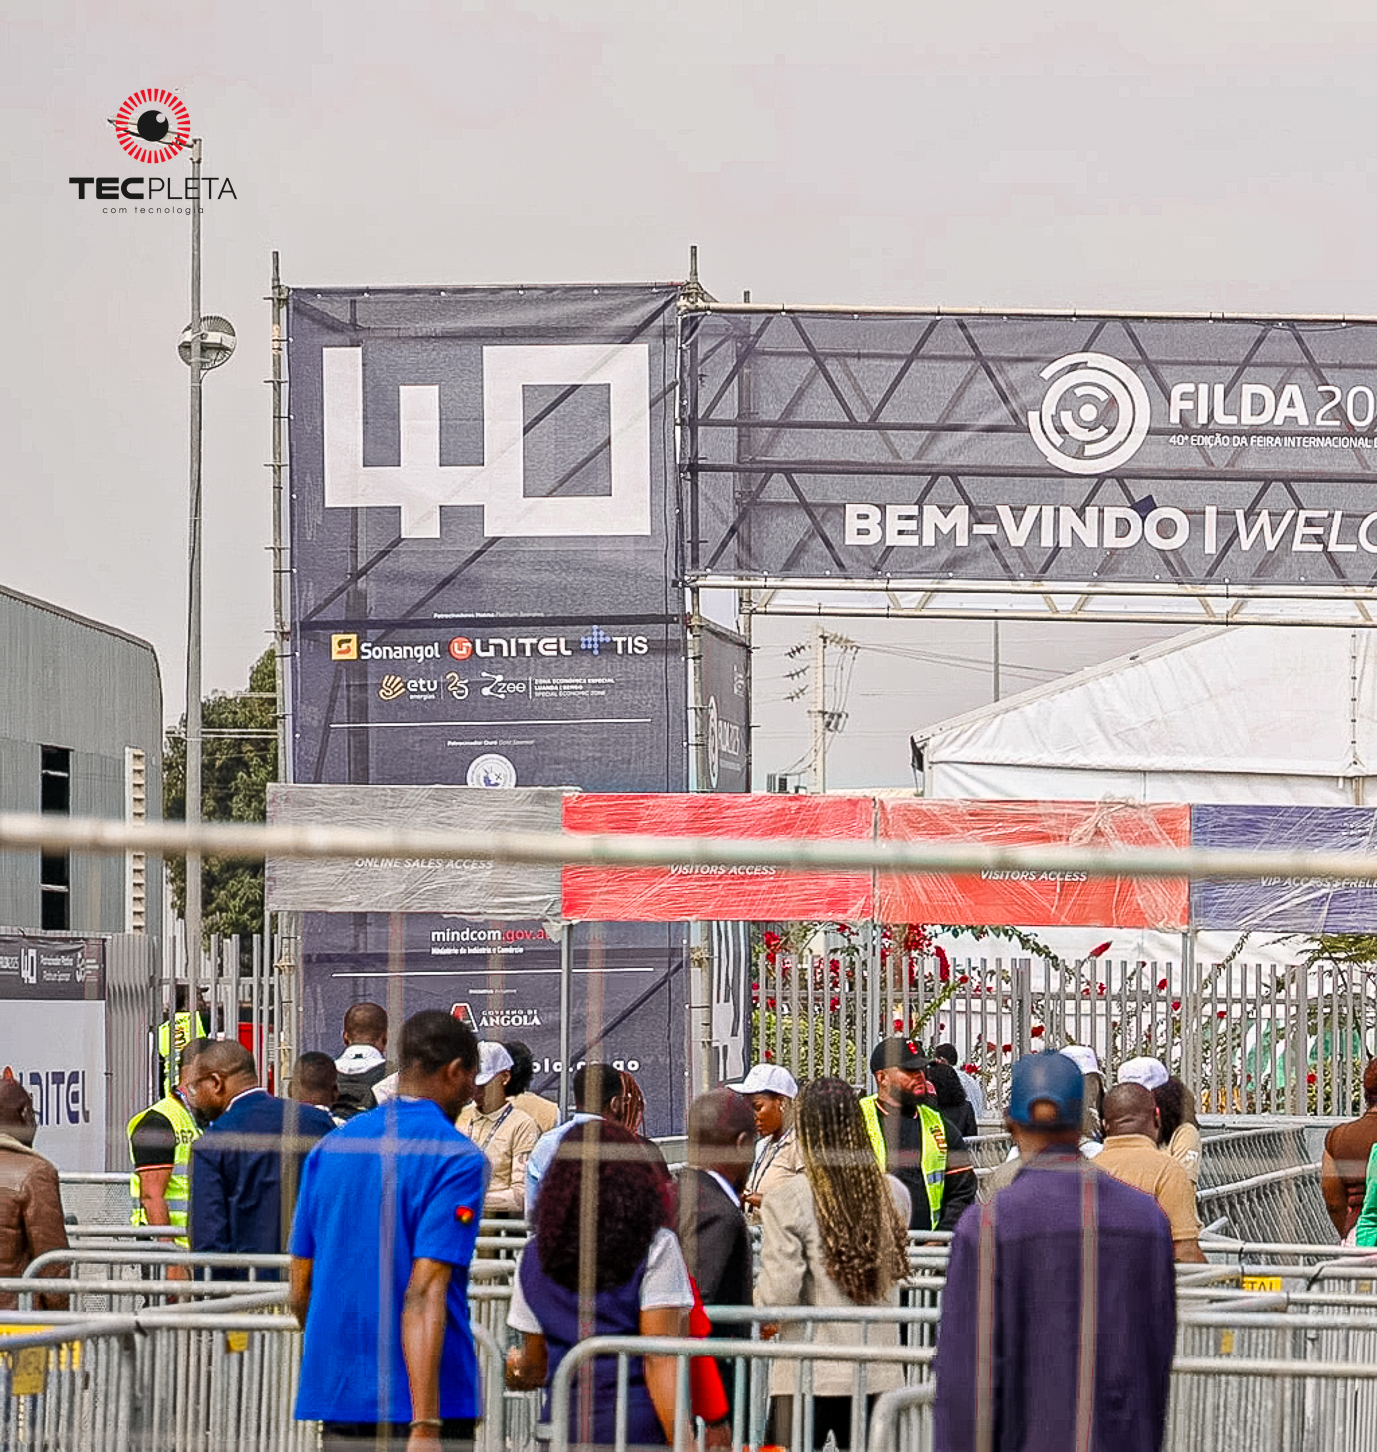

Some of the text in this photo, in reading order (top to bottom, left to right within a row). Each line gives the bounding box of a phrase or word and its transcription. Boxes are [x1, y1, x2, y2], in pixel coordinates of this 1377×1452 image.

[322, 343, 651, 538] 40
[1190, 433, 1230, 448] EDIÇÃO
[1233, 436, 1248, 447] DA
[1250, 436, 1281, 448] FEIRA
[1284, 436, 1372, 449] INTERNACIONAL
[843, 502, 1190, 552] BEM-VINDO
[360, 635, 649, 663] Sonangol UNITEL TIS
[406, 677, 437, 692] etu
[355, 858, 494, 869] ONLINE SALES ACCESS
[669, 864, 777, 875] VISITORS ACCESS
[981, 870, 1088, 881] VISITORS ACCESS
[1261, 877, 1280, 887] VIP
[431, 927, 551, 943] mindcom.gov.a
[479, 1015, 542, 1027] ANGOLA
[19, 1070, 90, 1126] NITEL
